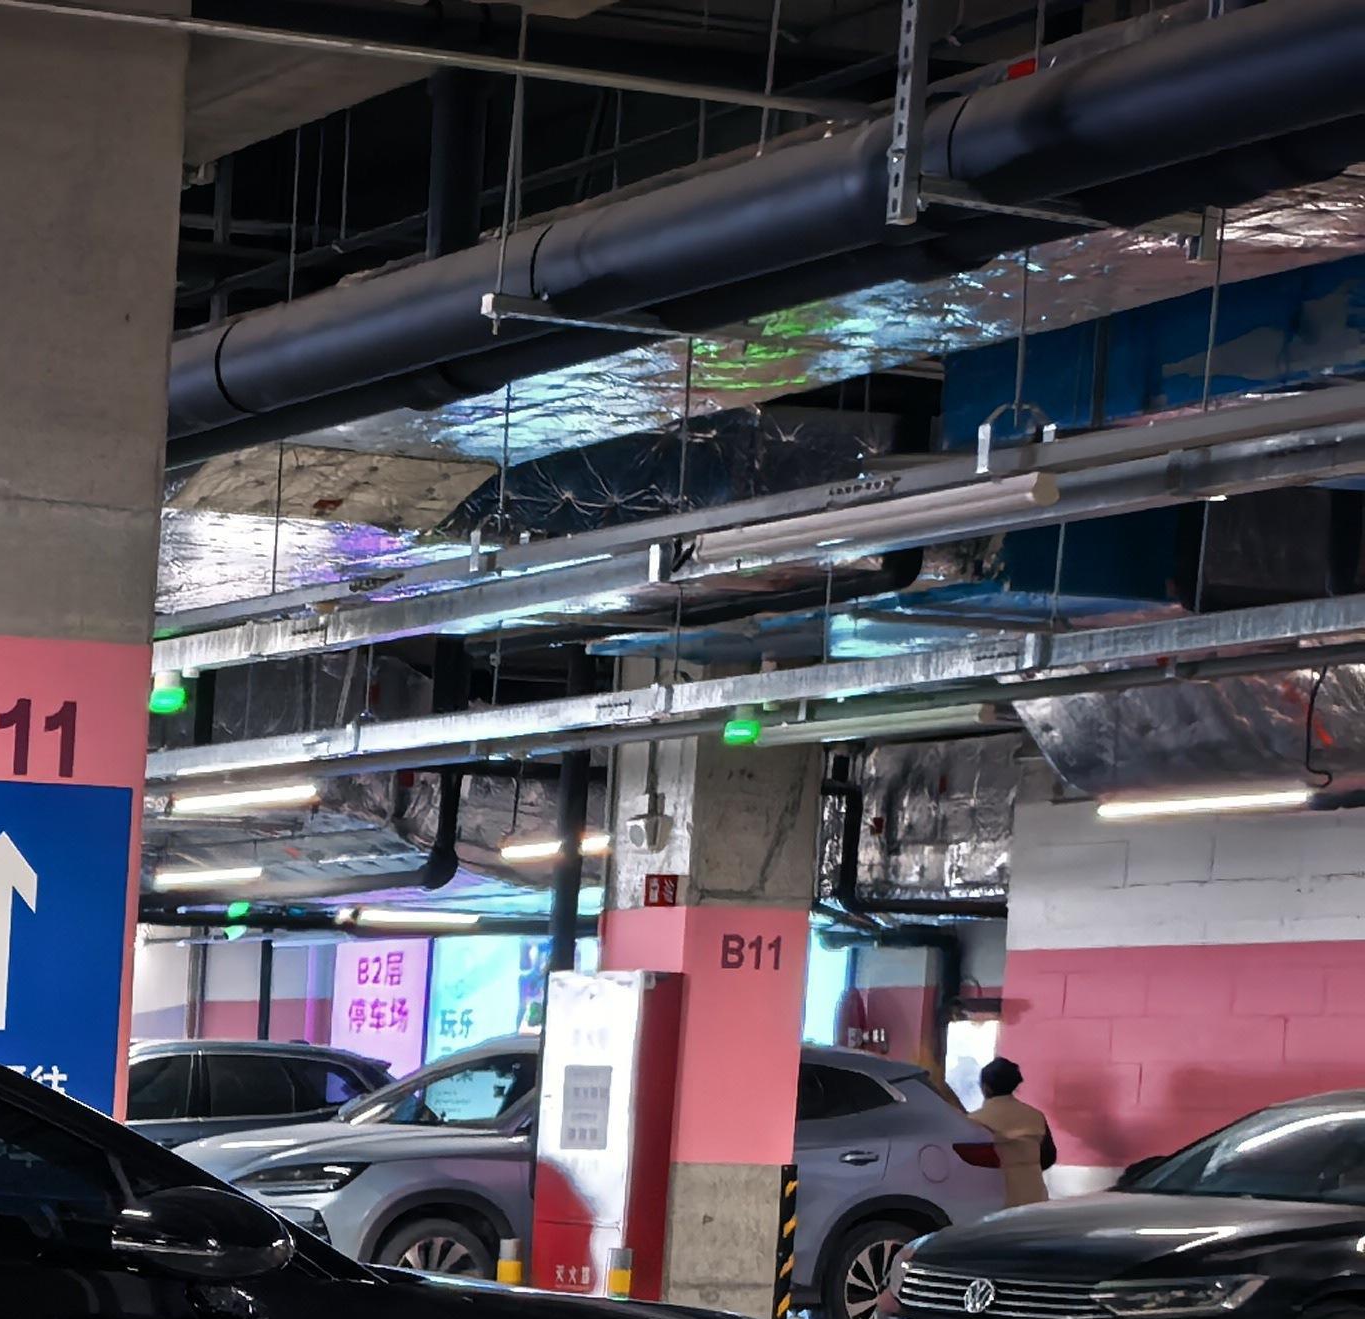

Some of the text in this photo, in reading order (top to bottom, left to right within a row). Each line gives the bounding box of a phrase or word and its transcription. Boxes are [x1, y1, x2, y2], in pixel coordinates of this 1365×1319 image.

[357, 951, 404, 987] B2层
[721, 934, 782, 970] B11
[348, 998, 410, 1034] 停车场
